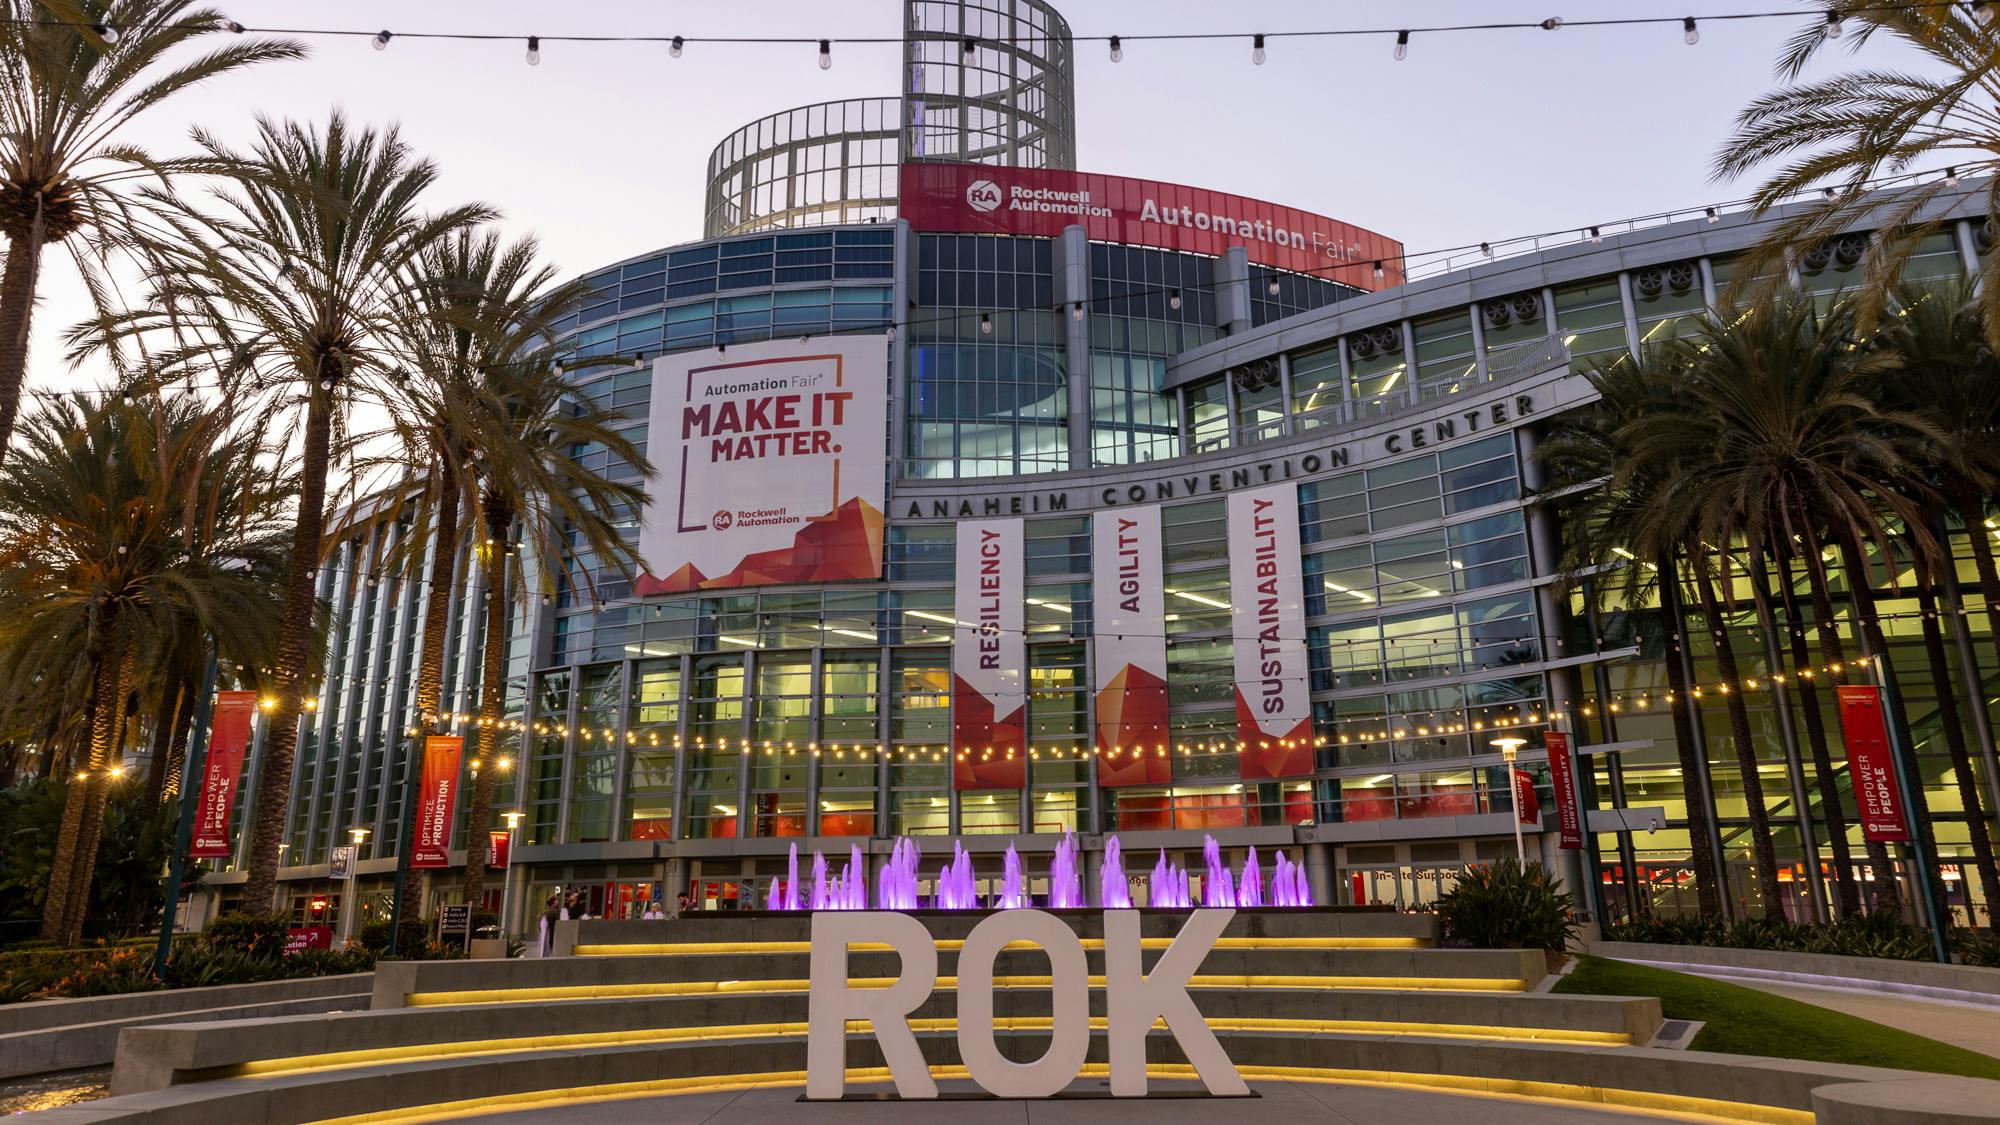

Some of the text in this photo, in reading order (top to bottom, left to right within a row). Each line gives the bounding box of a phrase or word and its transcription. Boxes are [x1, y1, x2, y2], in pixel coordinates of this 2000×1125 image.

[1009, 198, 1113, 217] Automation
[1010, 186, 1090, 203] Rockwell
[1140, 199, 1306, 250] Automation
[705, 378, 787, 397] Automation
[682, 392, 853, 440] MAKE IT
[711, 430, 842, 463] MATTER.
[908, 394, 1532, 517] ANAHEIM CONVENTION CENTER
[736, 516, 800, 528] Automation
[738, 507, 786, 519] Rockwell
[1119, 518, 1140, 613] AGILITY
[980, 529, 1000, 670] RESILIENCY
[1254, 499, 1284, 714] SUSTAINABILITY
[204, 764, 220, 829] EMPOWER
[215, 778, 229, 829] PEOPLE
[1560, 754, 1576, 830] SUSTAINABILITY
[1858, 755, 1880, 815] EMPOWER
[1874, 767, 1893, 815] PEOPLE
[421, 799, 435, 846] OPTIMIZE
[432, 780, 449, 846] PRODUCTION
[1562, 801, 1570, 829] DRIVE
[806, 908, 1251, 1099] ROK
